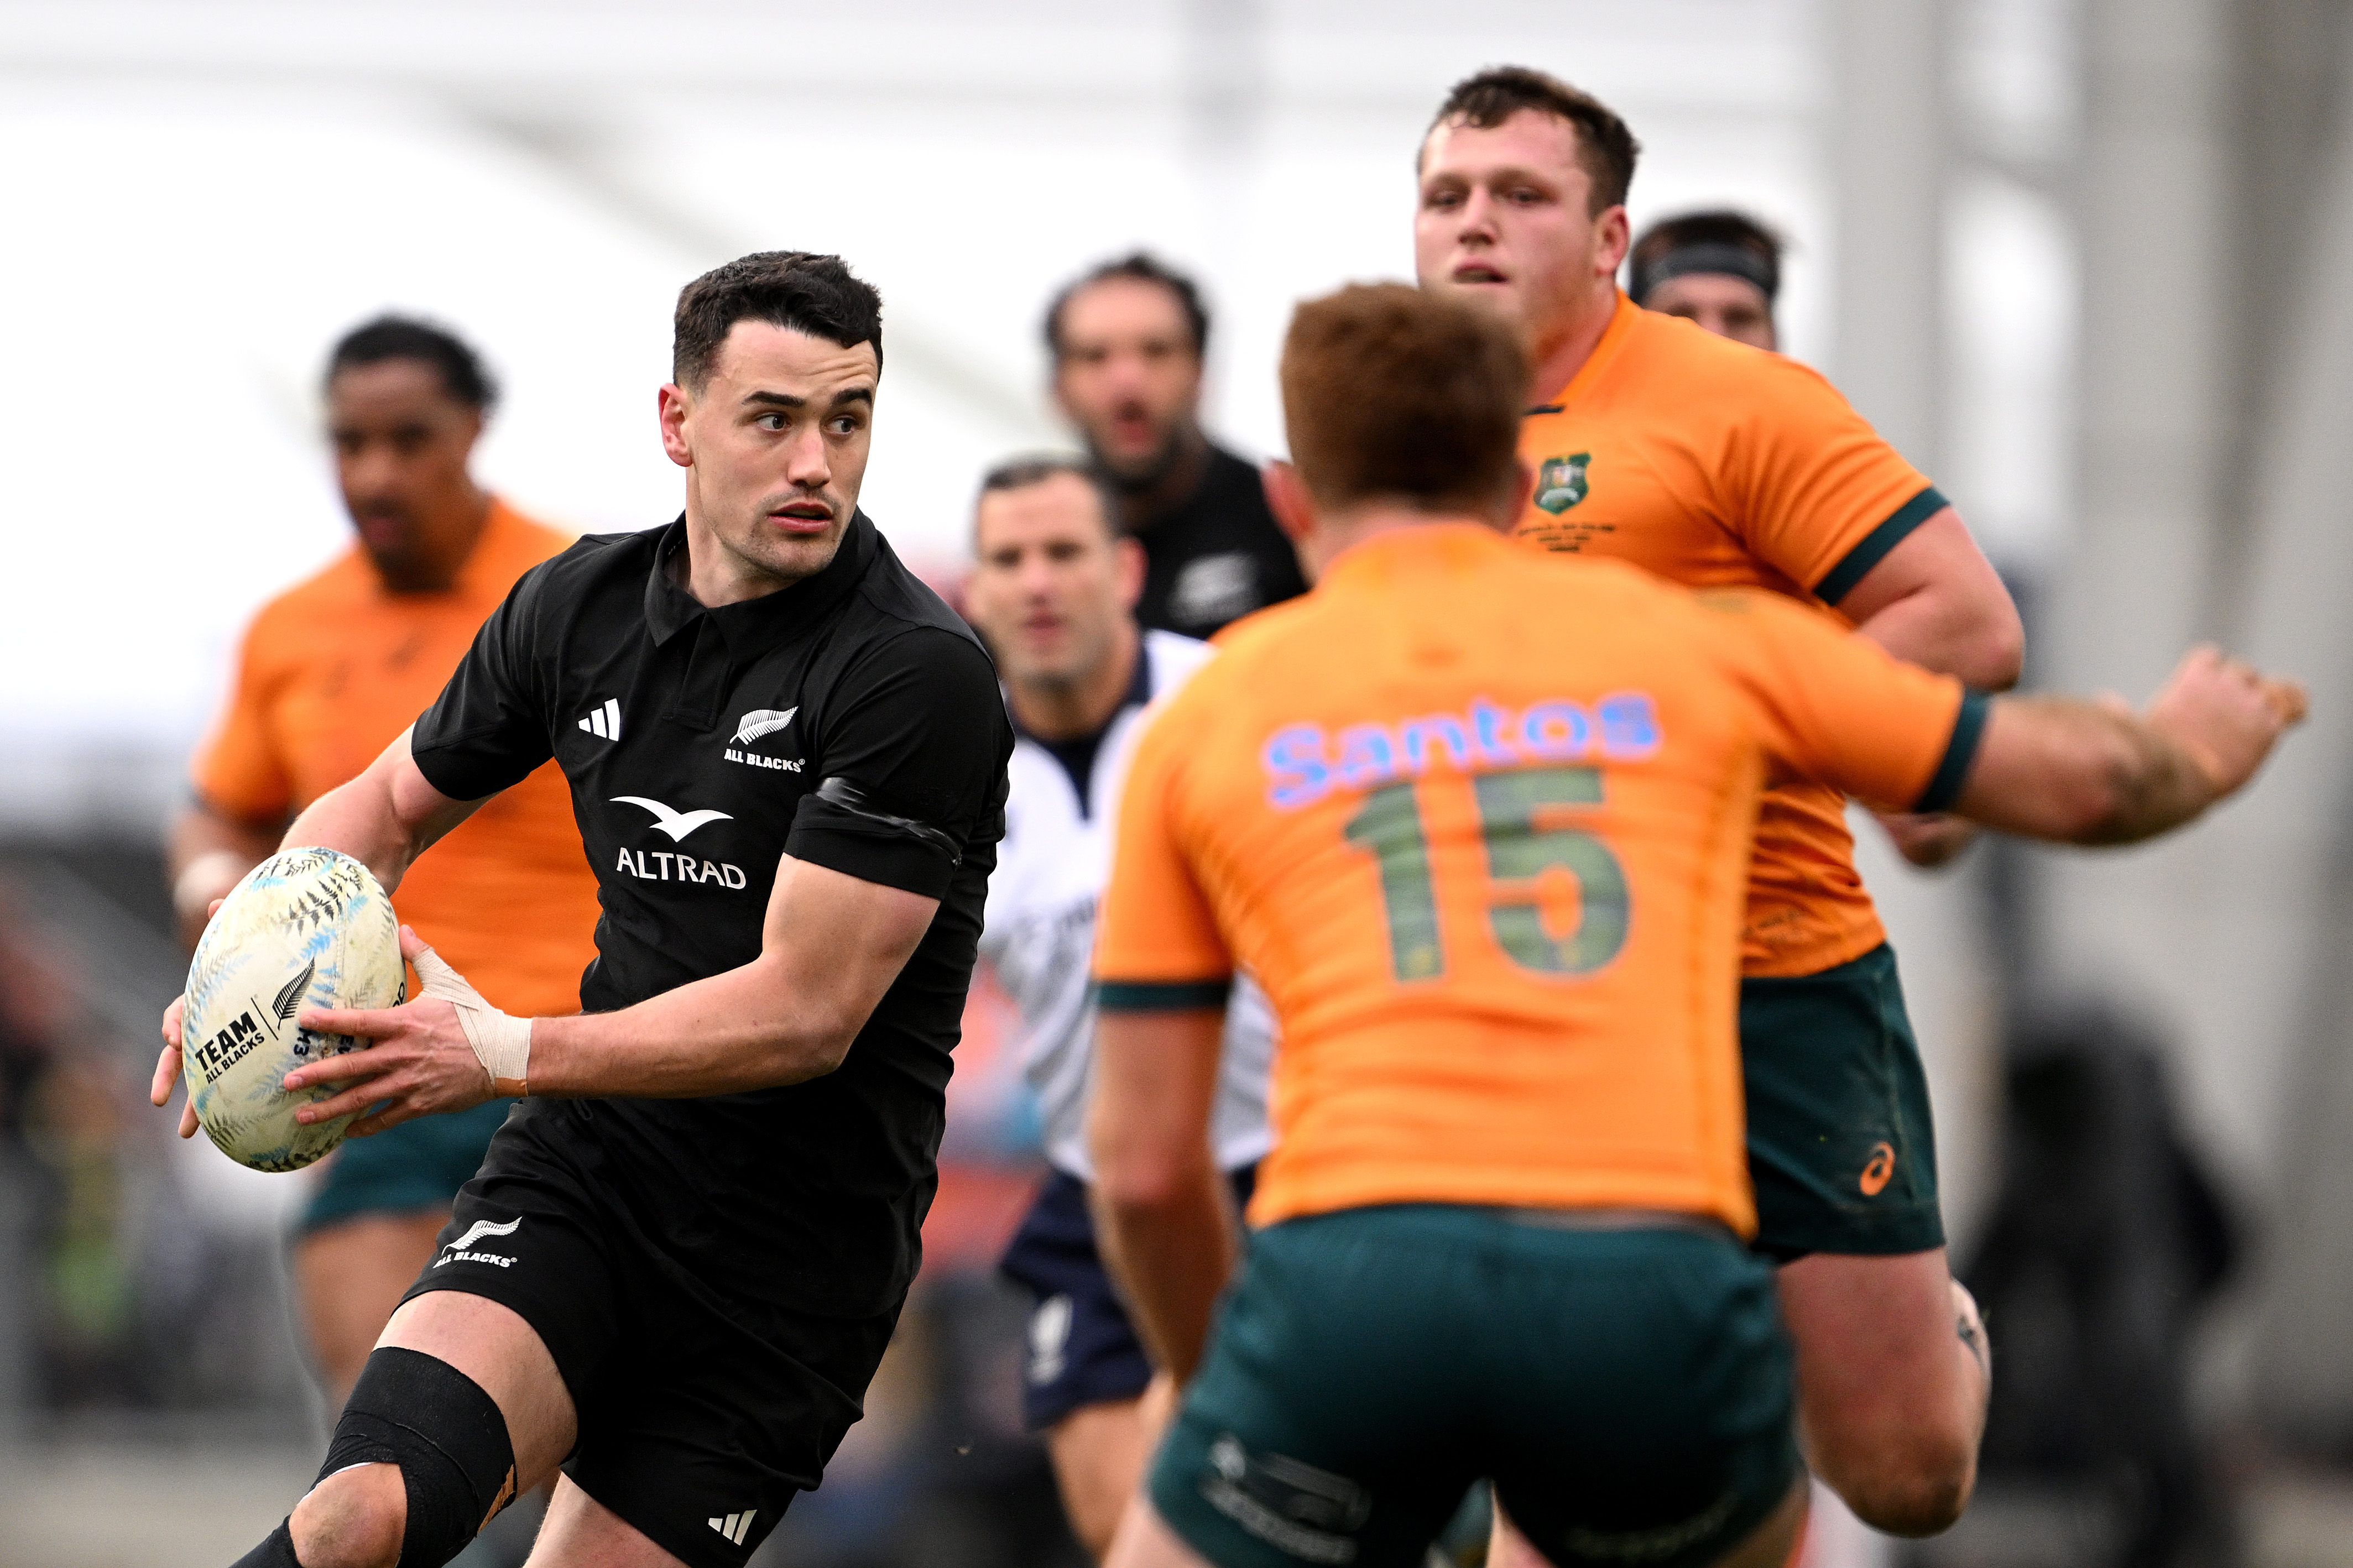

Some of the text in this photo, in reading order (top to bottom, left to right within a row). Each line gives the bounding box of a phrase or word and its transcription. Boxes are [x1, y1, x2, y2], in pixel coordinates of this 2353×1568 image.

[724, 748, 744, 763] ALL
[1264, 693, 1660, 809] Santos
[616, 847, 747, 890] ALTRAD
[1343, 765, 1631, 982] 15
[195, 1011, 258, 1072] TEAM
[205, 1032, 265, 1084] ALL BLACKS
[433, 1253, 451, 1268] ALL
